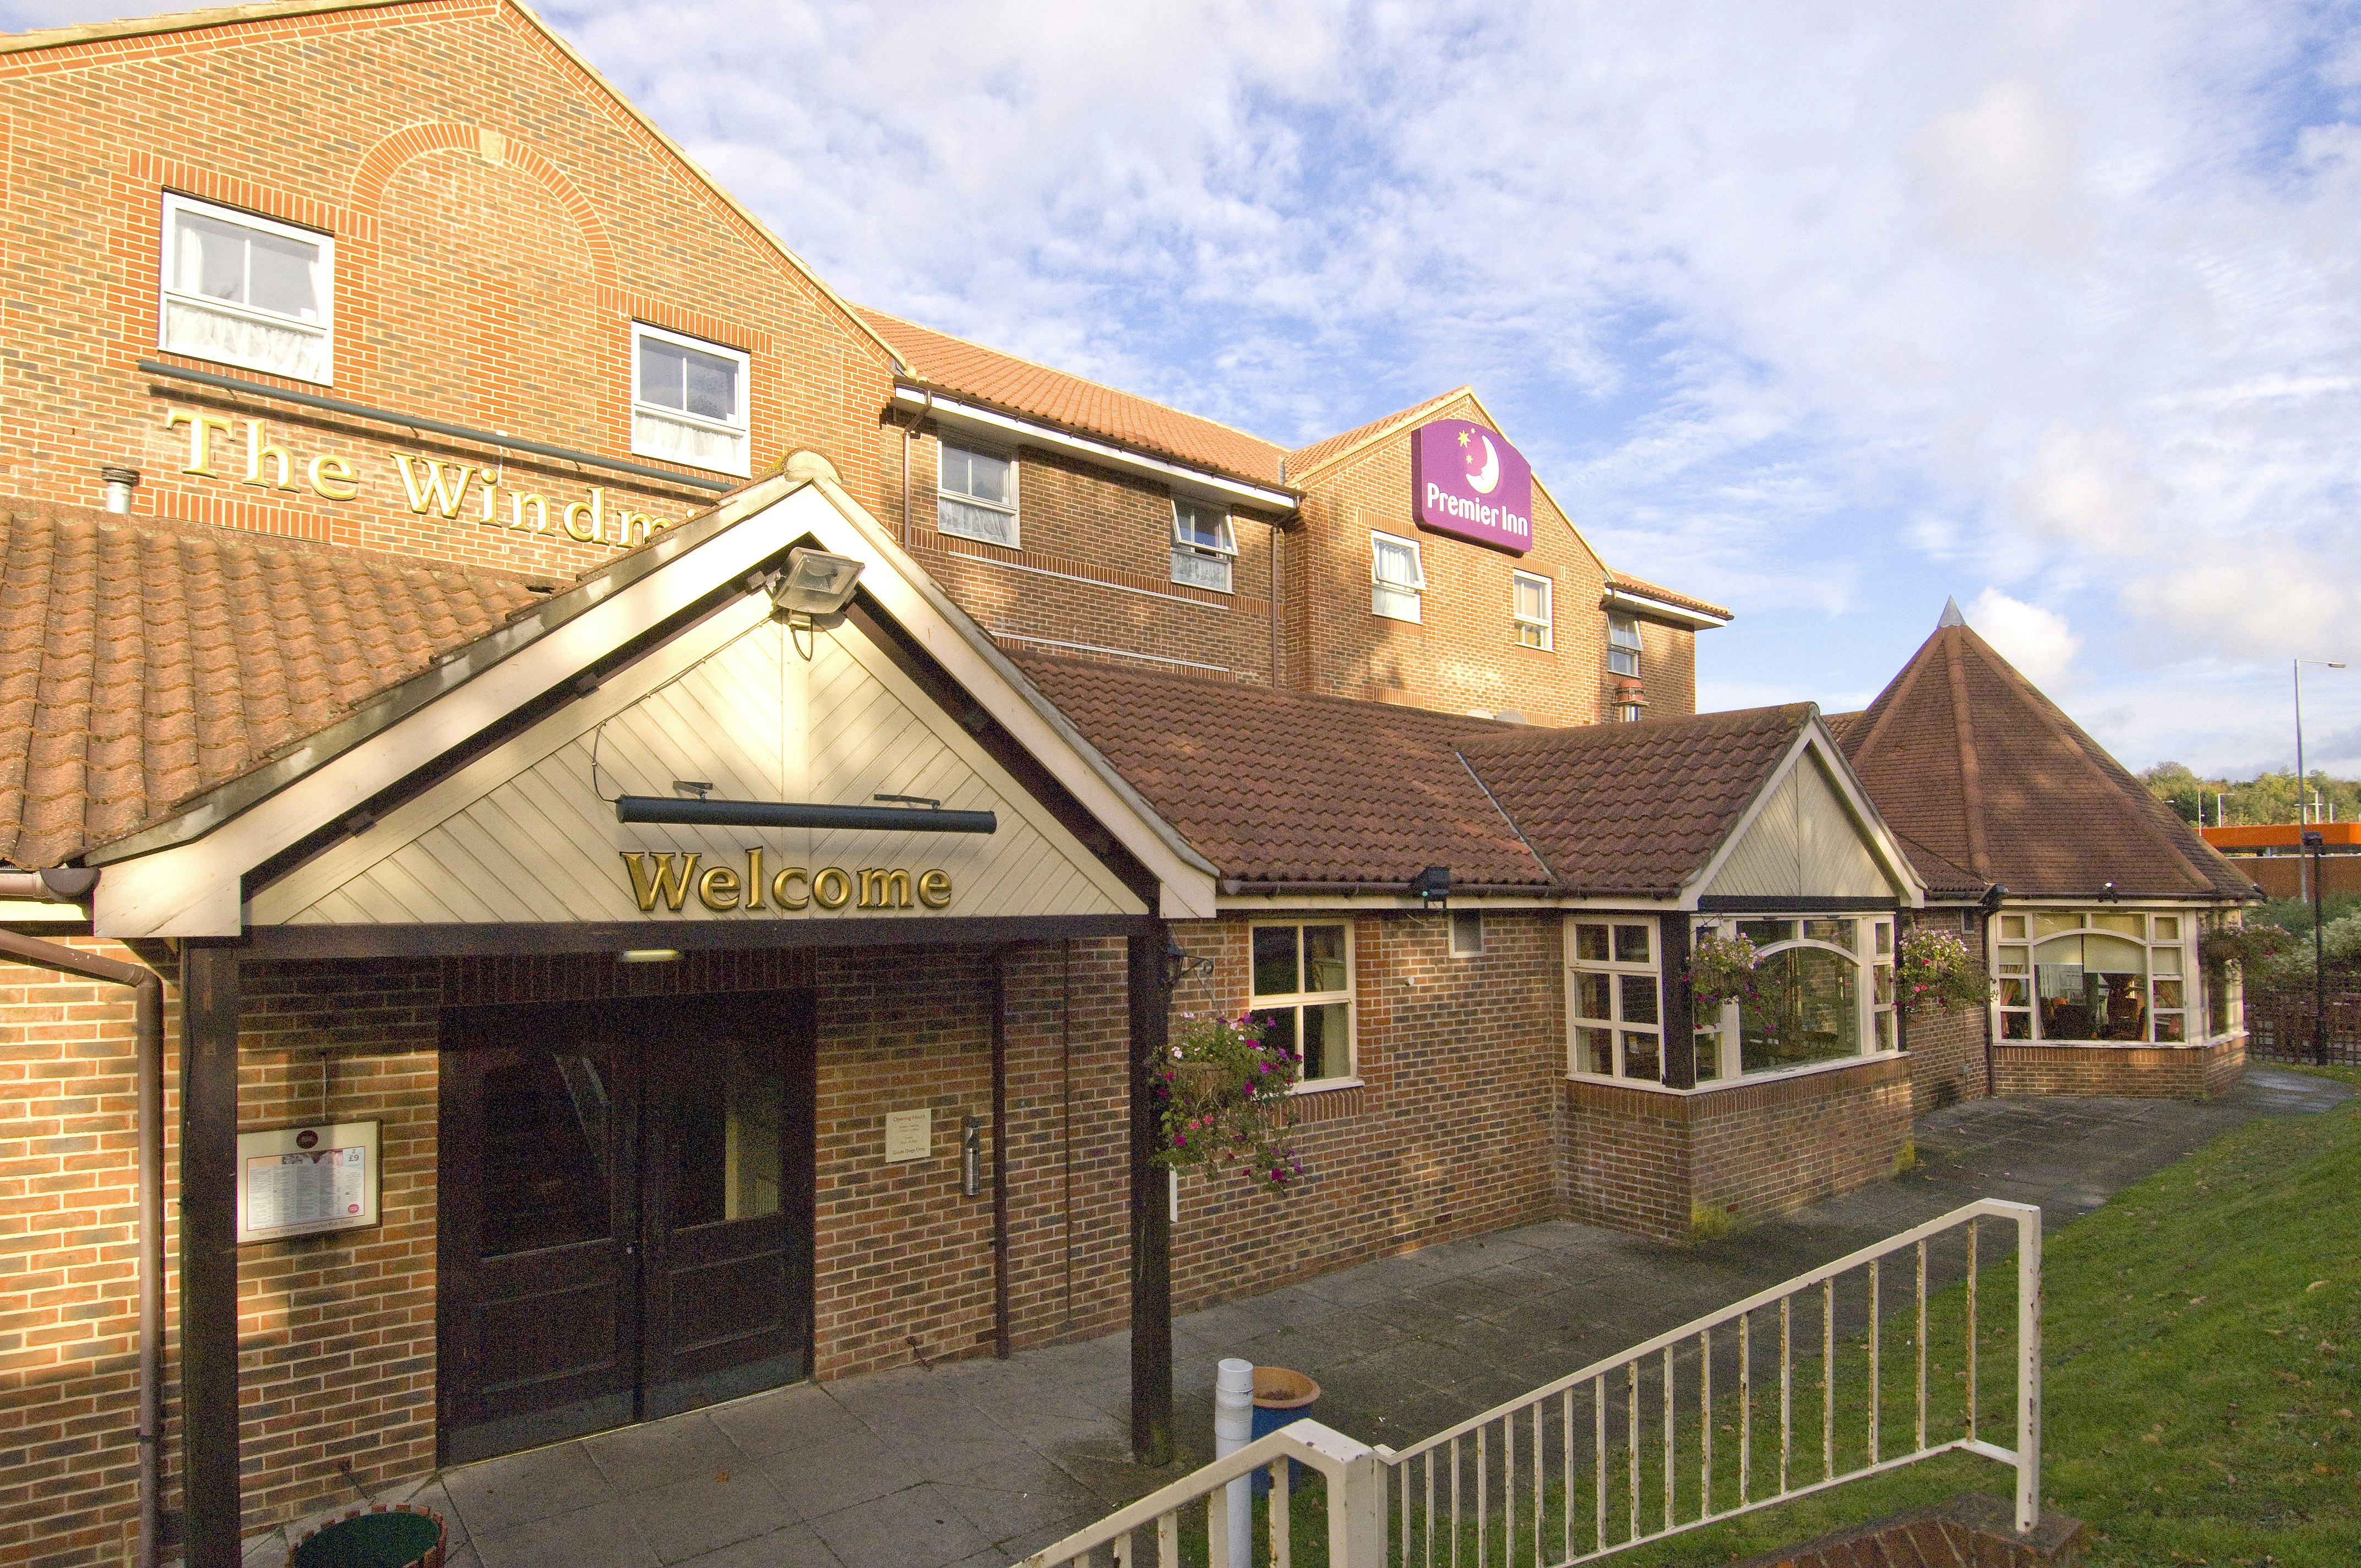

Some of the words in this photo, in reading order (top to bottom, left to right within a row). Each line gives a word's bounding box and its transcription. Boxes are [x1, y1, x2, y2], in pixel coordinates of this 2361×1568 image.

[166, 409, 360, 502] The
[389, 451, 698, 548] Windm
[1427, 482, 1500, 527] Premier
[1502, 505, 1529, 537] Inn
[619, 846, 953, 912] Welcome
